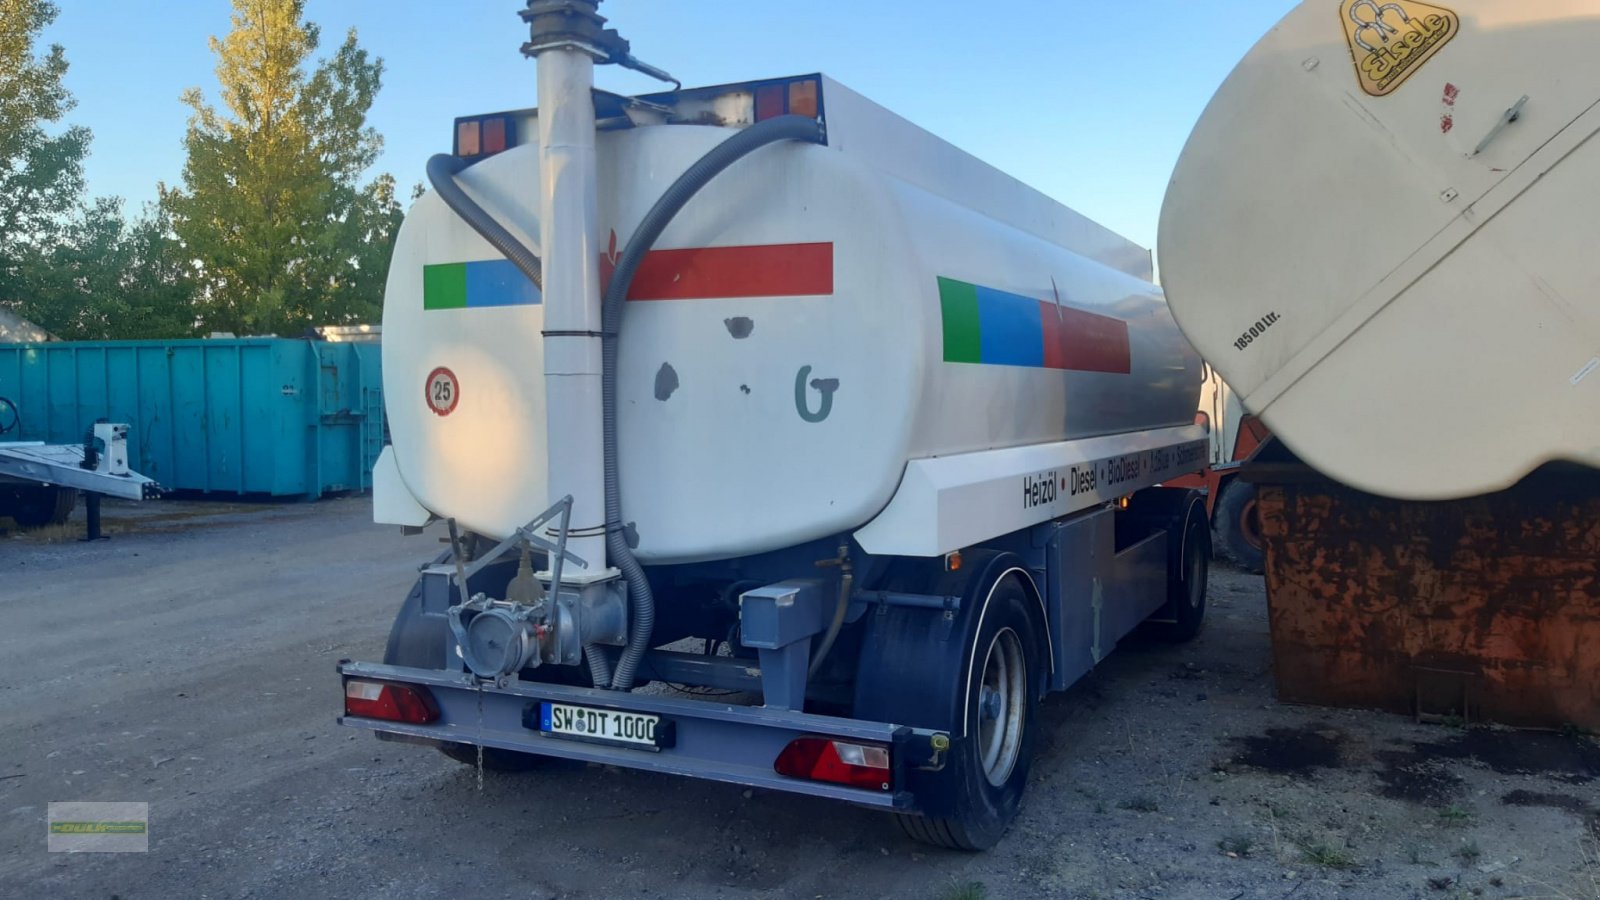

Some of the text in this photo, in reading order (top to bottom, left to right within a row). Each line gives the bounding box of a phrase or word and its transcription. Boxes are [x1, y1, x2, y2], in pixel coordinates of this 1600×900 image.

[1361, 14, 1450, 81] Eisele
[434, 380, 451, 401] 25
[1023, 471, 1057, 509] Heizöl
[1071, 463, 1097, 496] Diesel
[1108, 456, 1140, 486] BioDiesel
[553, 707, 655, 740] SW DT 1000
